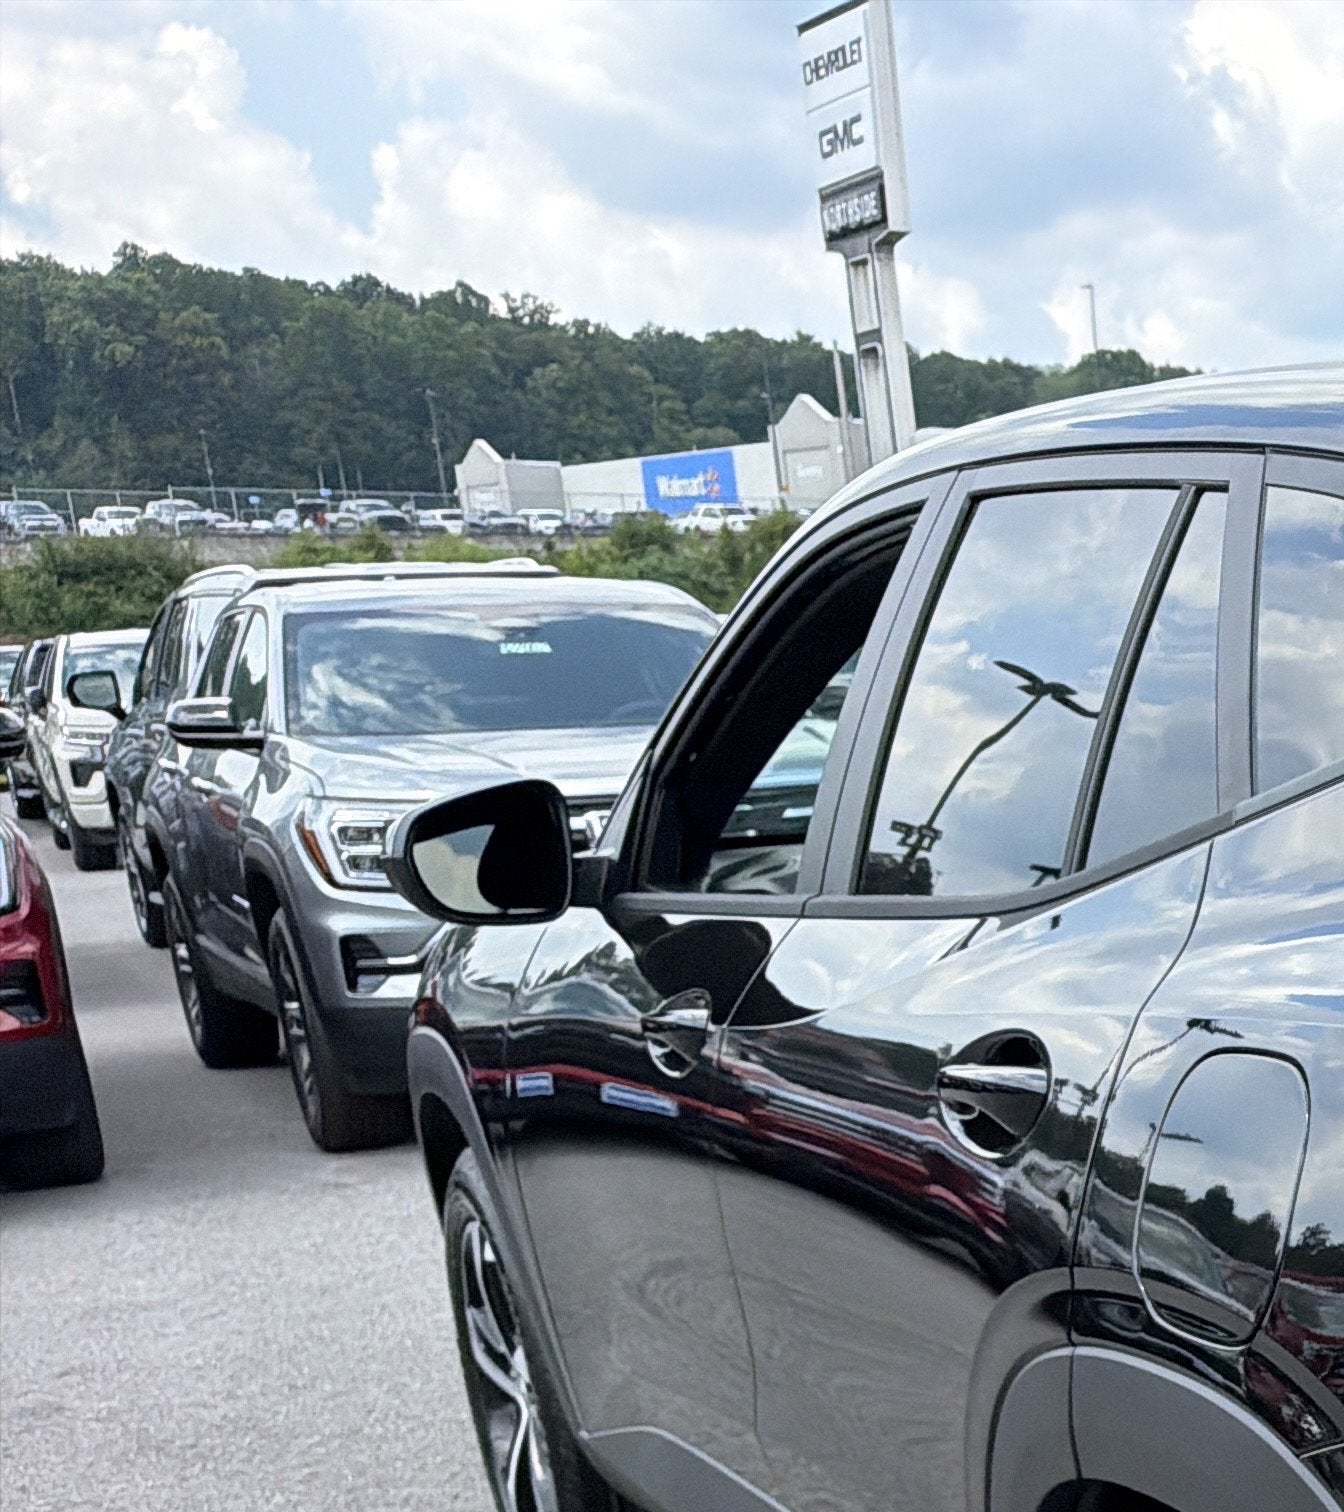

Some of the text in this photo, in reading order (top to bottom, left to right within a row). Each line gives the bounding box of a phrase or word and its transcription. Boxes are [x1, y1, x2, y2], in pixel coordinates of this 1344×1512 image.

[803, 36, 862, 86] CHEVROLET
[819, 113, 864, 159] GMC
[656, 470, 706, 498] Walmart
